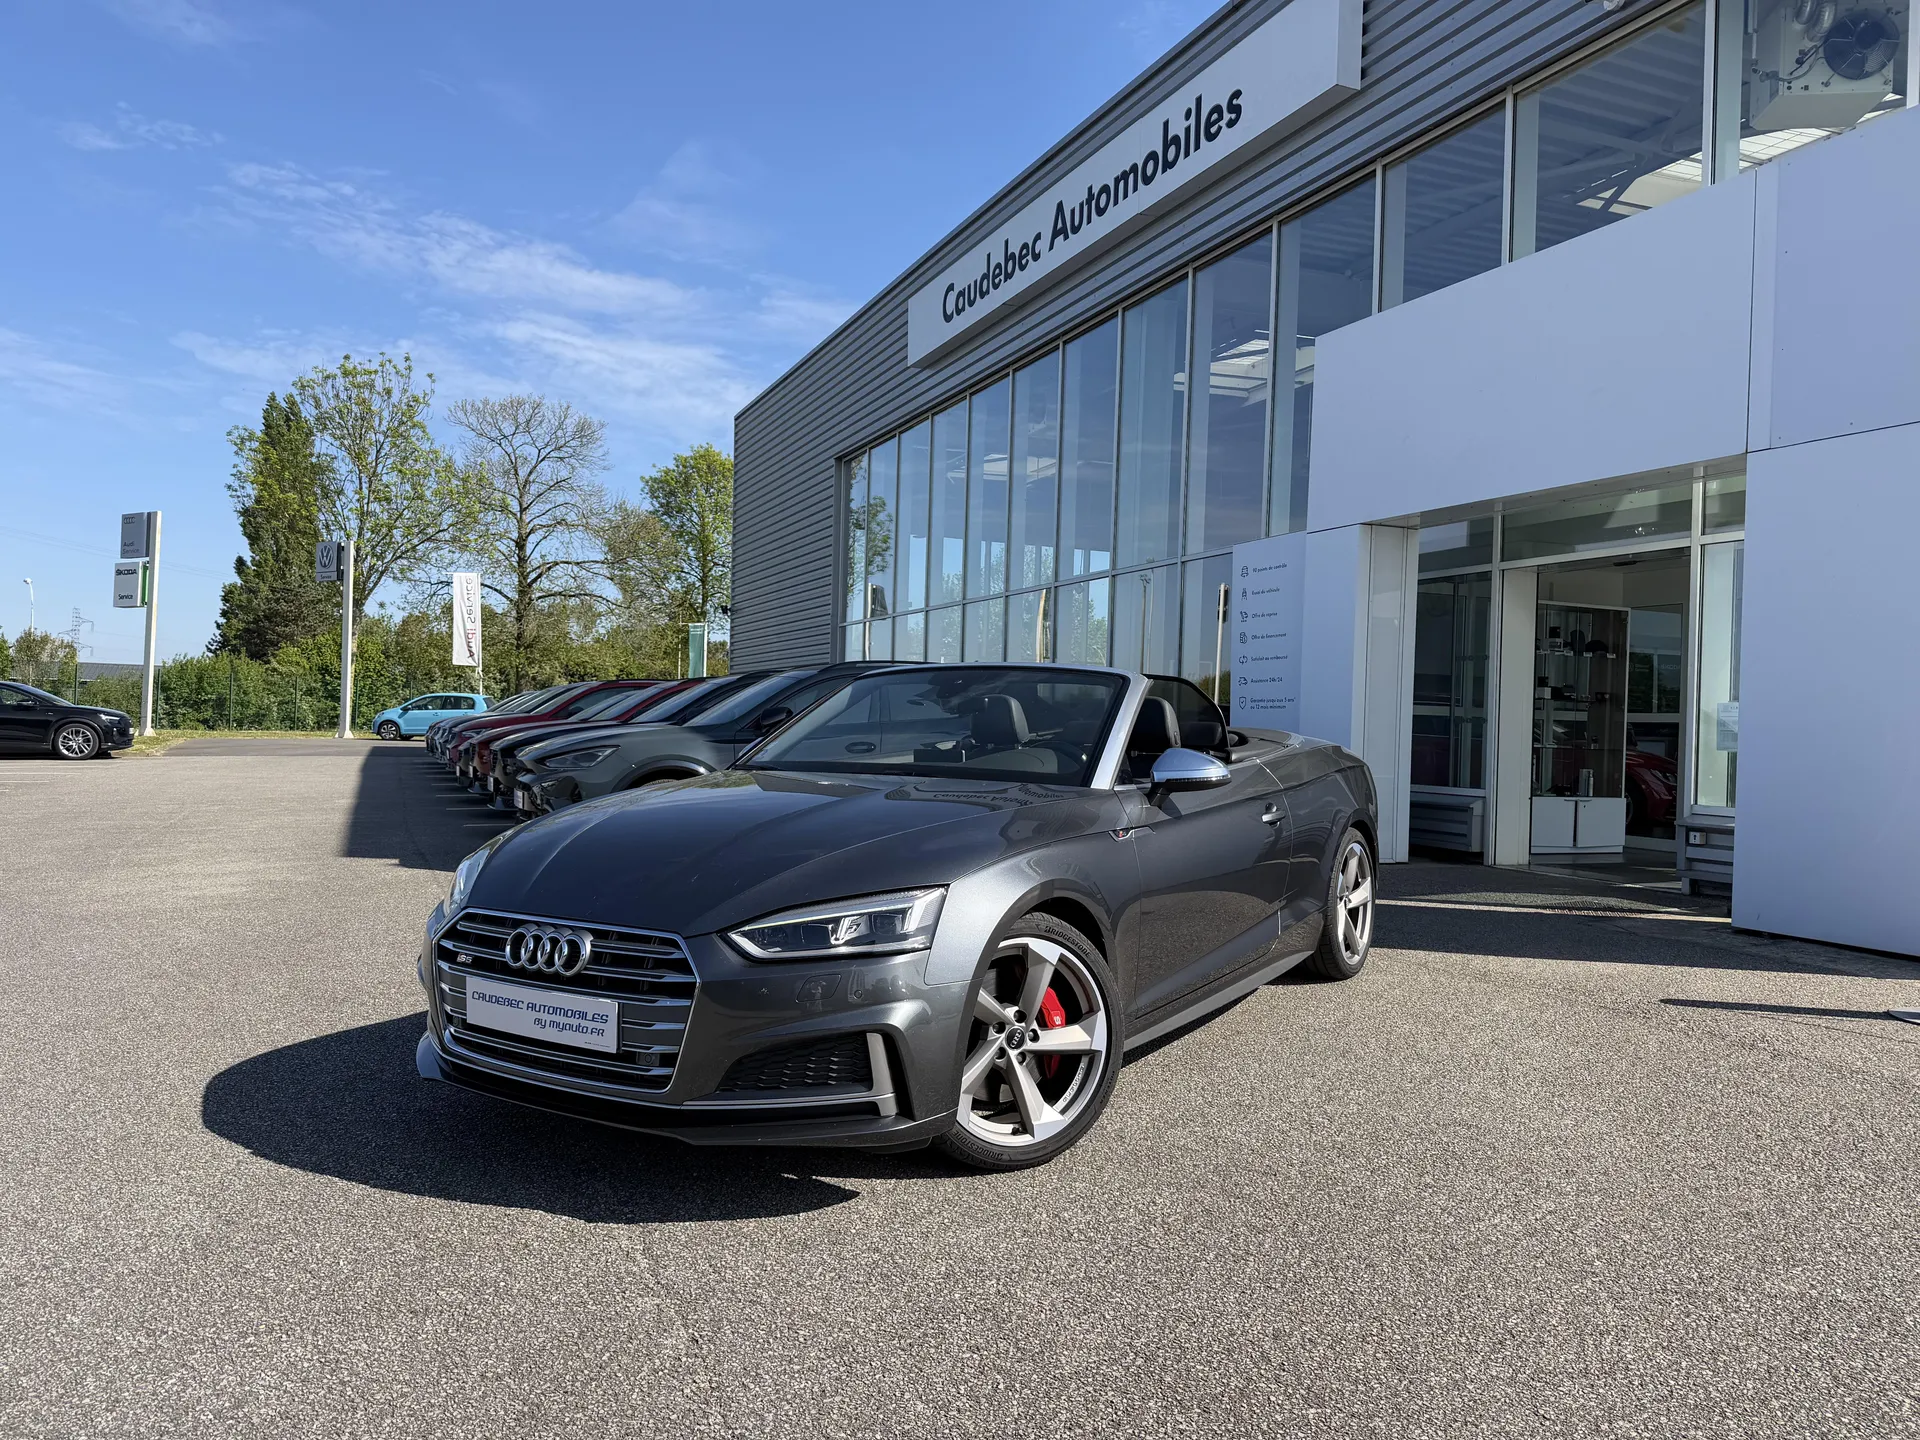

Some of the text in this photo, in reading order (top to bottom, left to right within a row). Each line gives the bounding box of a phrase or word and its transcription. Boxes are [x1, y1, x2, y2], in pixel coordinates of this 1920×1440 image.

[942, 88, 1243, 324] Caudebec Automobiles
[1044, 925, 1092, 958] BRIDGESTONE
[471, 990, 609, 1024] CAUDEBEC AUTOMOBILES
[952, 1130, 1004, 1161] BRIDGESTONE
